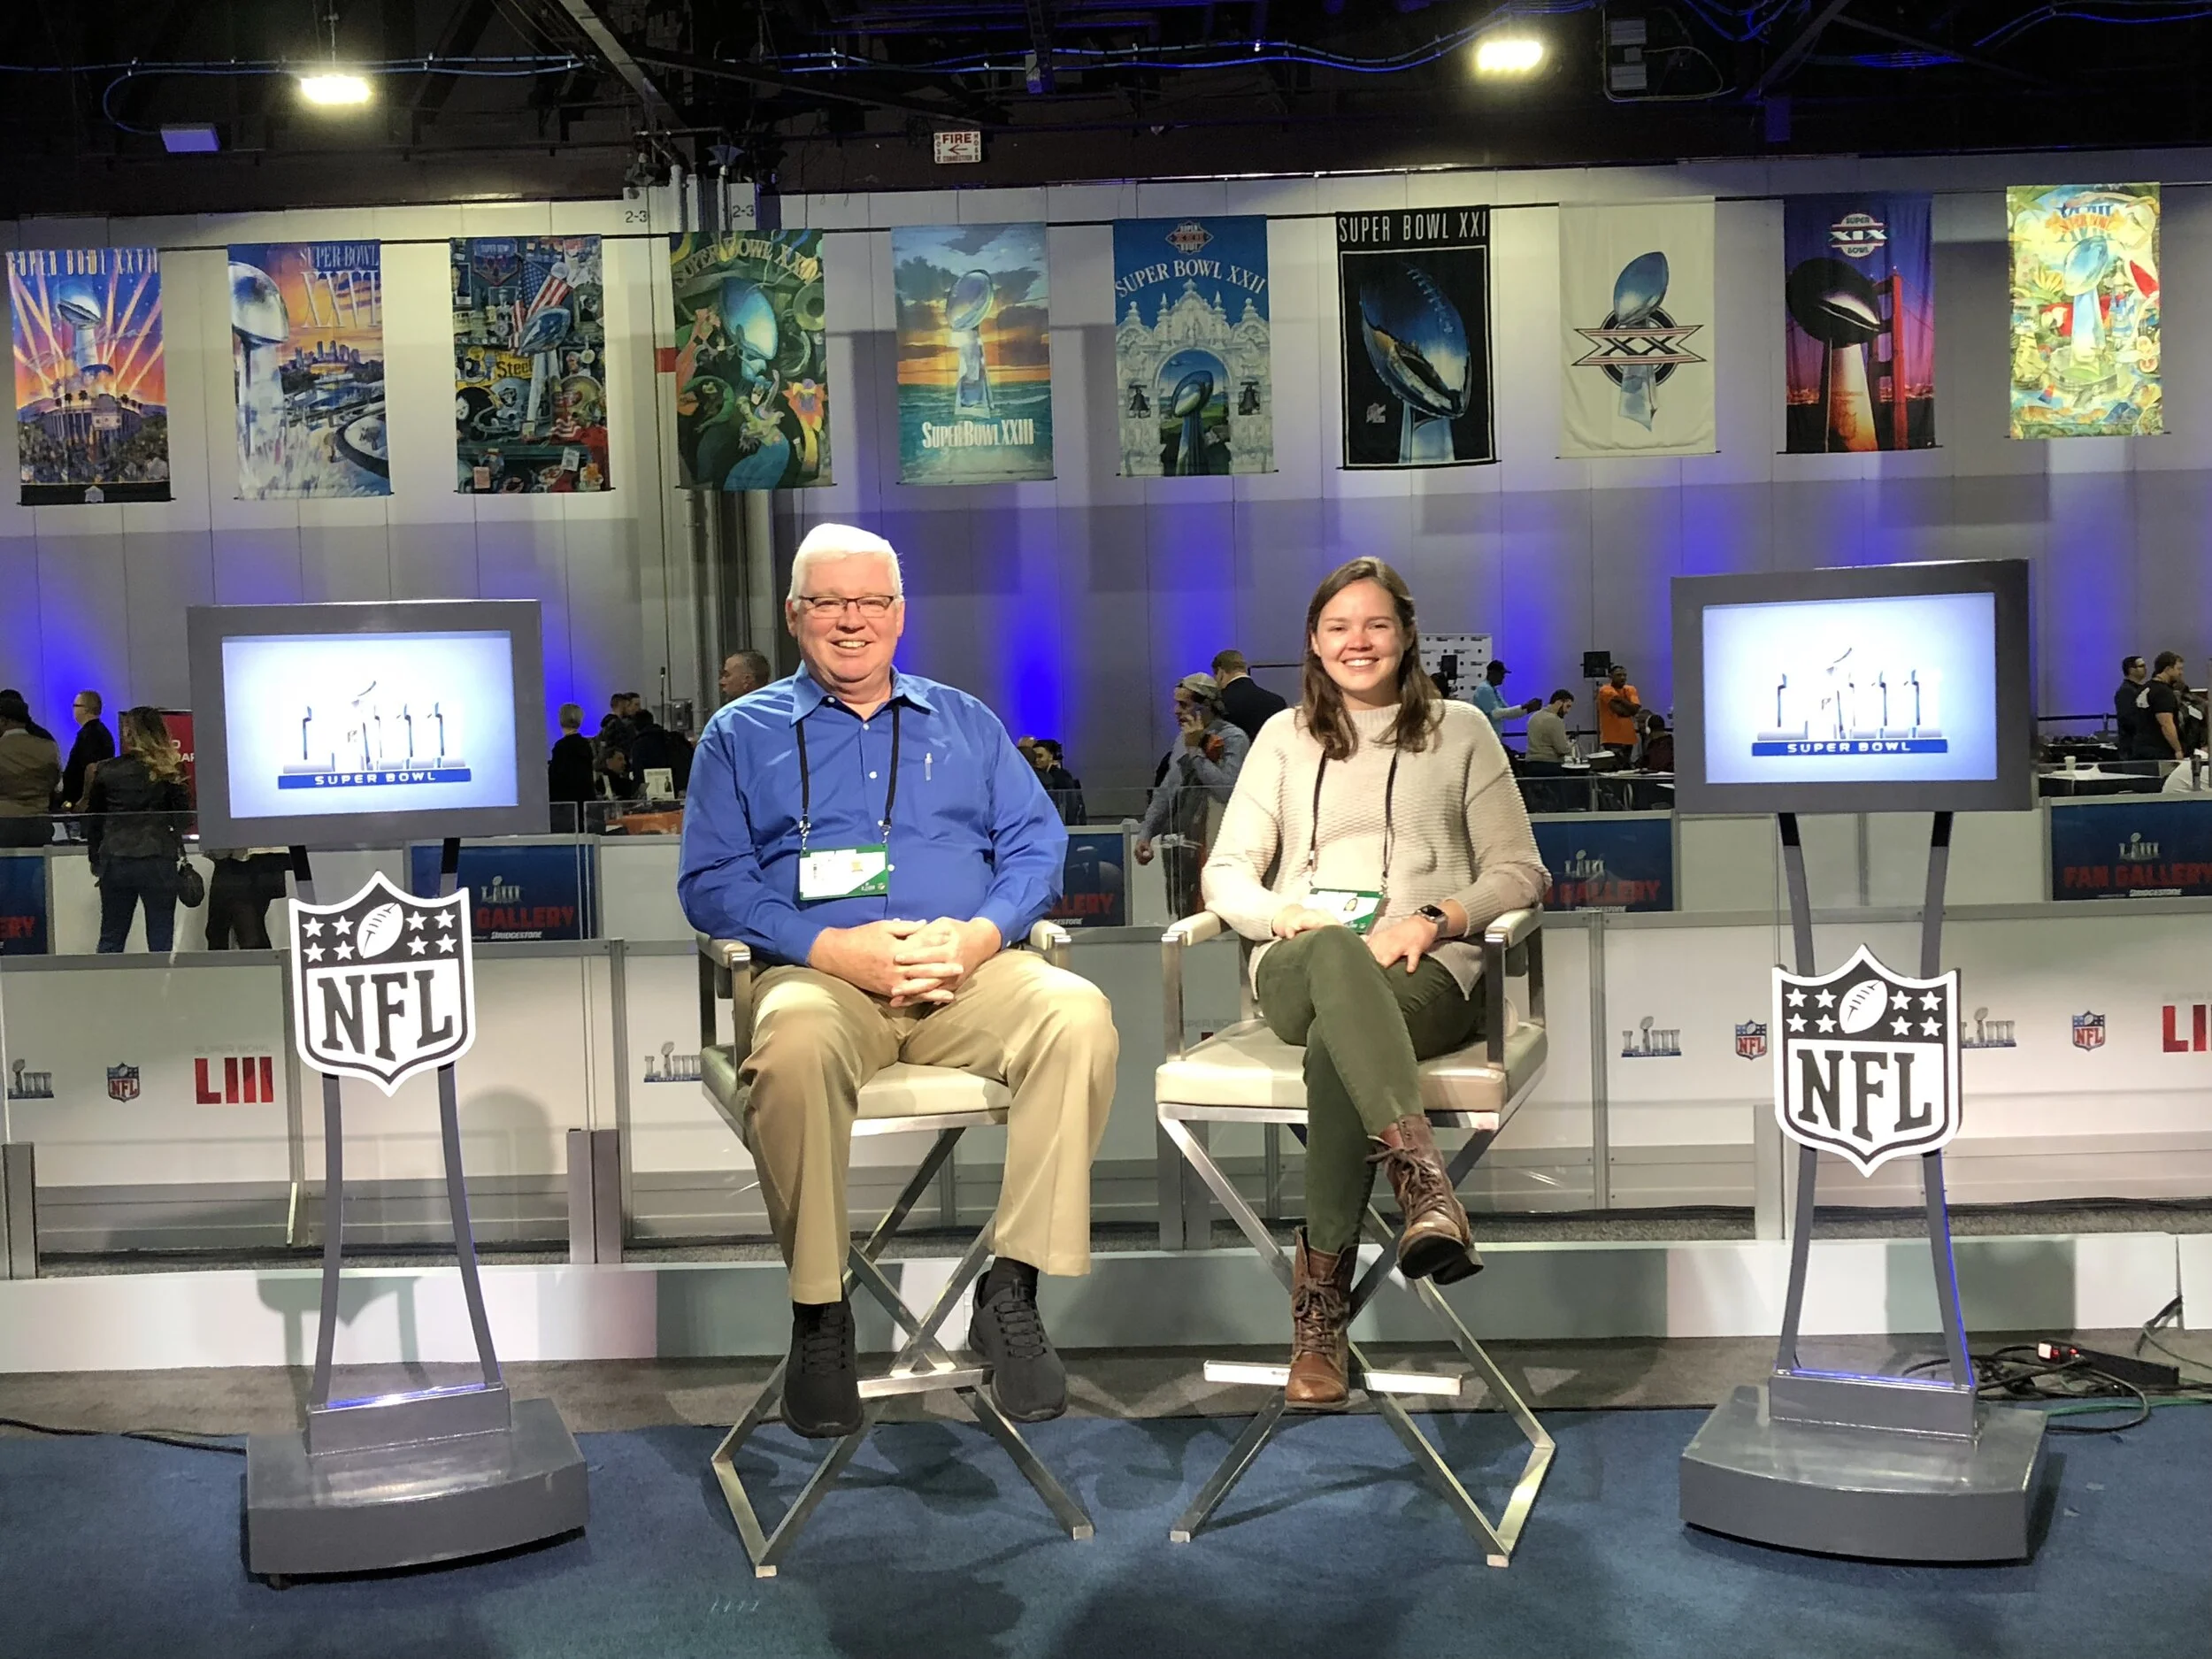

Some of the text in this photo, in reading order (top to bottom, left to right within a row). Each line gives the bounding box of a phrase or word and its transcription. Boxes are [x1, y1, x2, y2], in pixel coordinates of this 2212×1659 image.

[942, 134, 972, 143] FIRE
[625, 211, 648, 223] 2-3
[733, 205, 755, 218] 2-3
[1339, 211, 1486, 242] SUPER BOWL XXI
[1828, 229, 1887, 242] XIX
[300, 244, 380, 267] SUPER BOWL
[672, 244, 722, 288] SUPER
[1115, 258, 1266, 297] SUPER BOWL XXII
[1600, 335, 1679, 356] XX
[1001, 419, 1034, 445] XXIII
[1787, 741, 1911, 753] SUPER BOWL
[315, 772, 436, 786] SUPER BOWL
[2064, 863, 2212, 887] FAN GALLERY
[1560, 879, 1662, 903] GALLERY
[476, 906, 574, 929] GALLERY
[317, 969, 453, 1062] NFL
[1738, 1037, 1765, 1056] NFL
[2076, 1027, 2104, 1047] NFL
[111, 1079, 138, 1098] NFL
[194, 1056, 273, 1104] LIII
[1796, 1048, 1932, 1142] NFL
